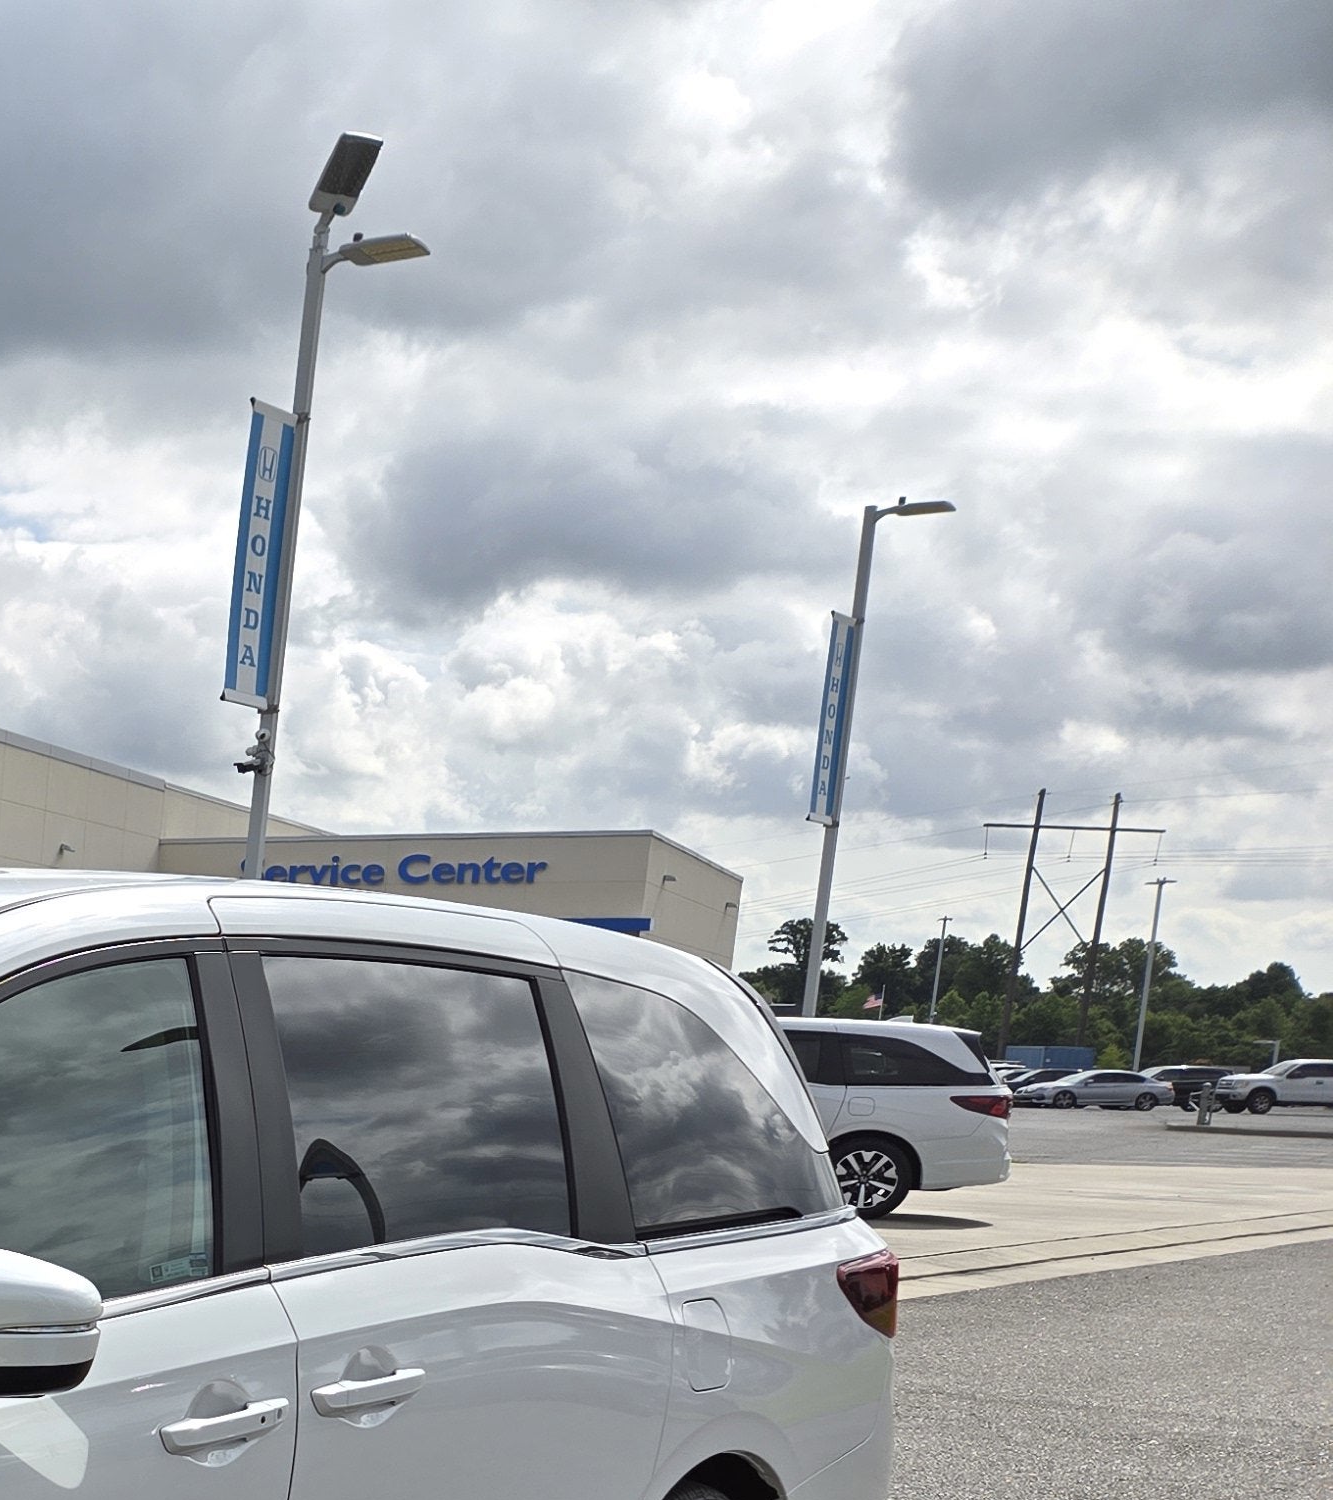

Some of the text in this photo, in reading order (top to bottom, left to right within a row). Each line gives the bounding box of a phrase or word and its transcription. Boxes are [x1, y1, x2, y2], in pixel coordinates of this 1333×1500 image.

[239, 494, 271, 668] HONDA
[817, 676, 839, 797] HONDA
[240, 853, 549, 885] ervice Center
